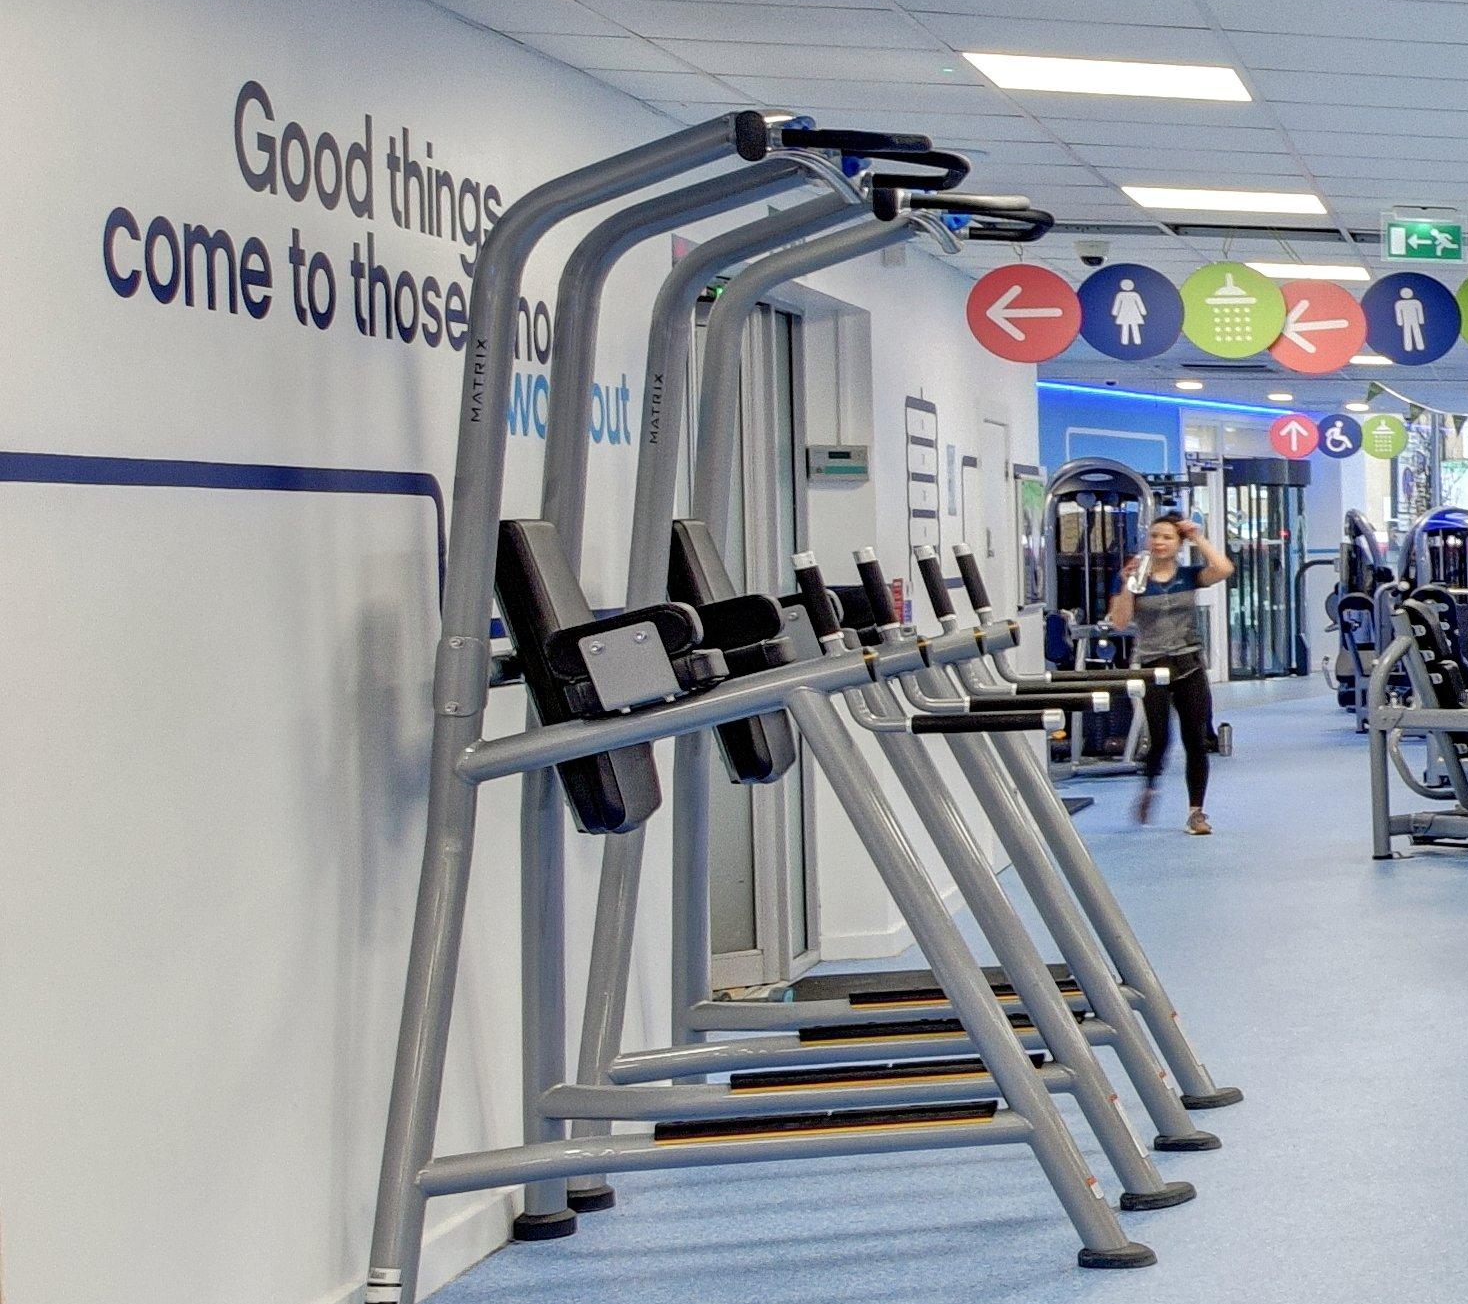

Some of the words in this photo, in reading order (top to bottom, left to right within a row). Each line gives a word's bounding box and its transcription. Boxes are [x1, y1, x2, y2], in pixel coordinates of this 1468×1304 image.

[234, 80, 374, 220] Good
[387, 126, 502, 278] things
[103, 206, 273, 320] come
[289, 227, 337, 330] to
[350, 231, 469, 351] those
[515, 296, 550, 365] ho
[471, 338, 488, 423] MATRIX
[650, 373, 664, 445] MATRIX
